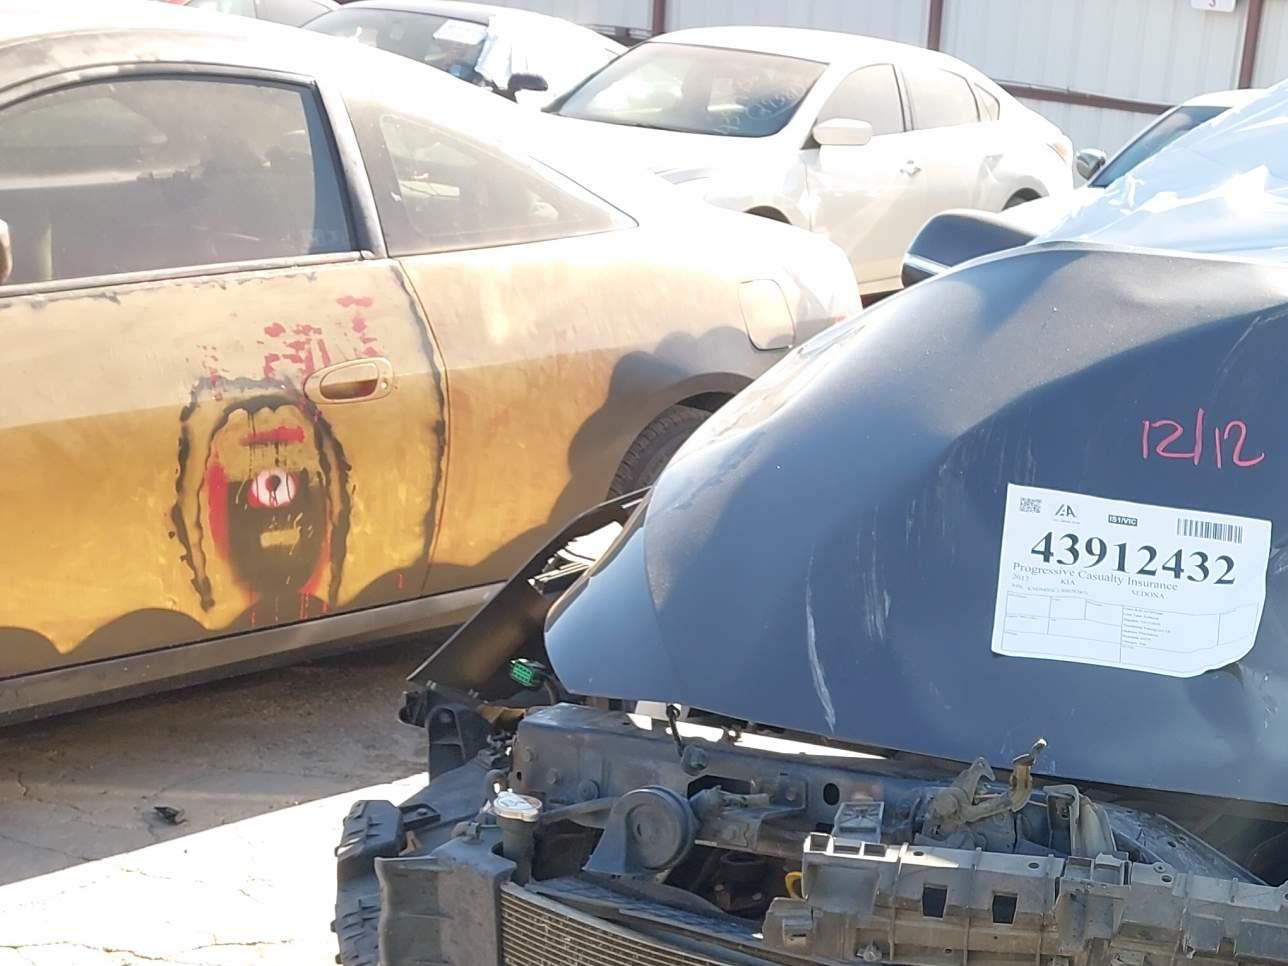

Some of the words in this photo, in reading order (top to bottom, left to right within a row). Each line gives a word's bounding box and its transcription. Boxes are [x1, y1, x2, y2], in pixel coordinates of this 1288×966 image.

[1141, 407, 1265, 470] 12/12
[1012, 562, 1075, 579] Progressive
[1078, 570, 1124, 587] Casualty
[1128, 577, 1179, 591] Insurance
[1031, 531, 1236, 586] 43912432
[1060, 578, 1076, 586] KIA
